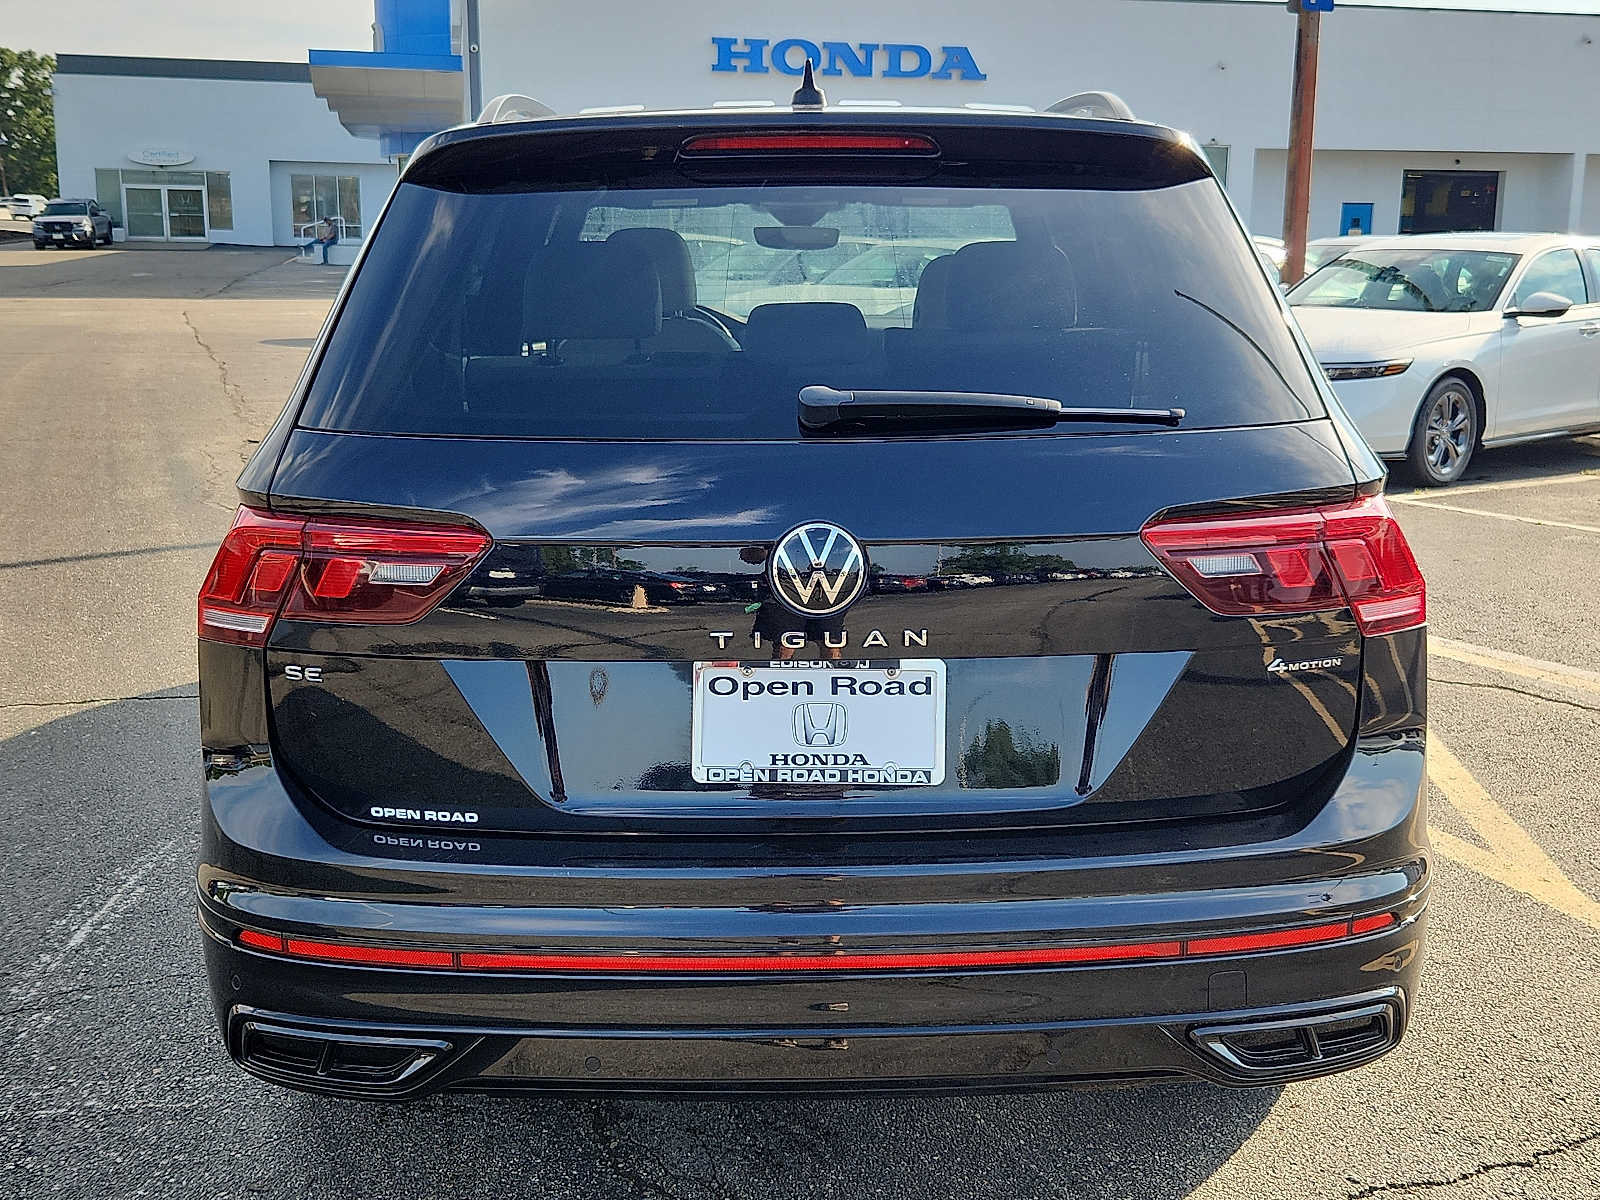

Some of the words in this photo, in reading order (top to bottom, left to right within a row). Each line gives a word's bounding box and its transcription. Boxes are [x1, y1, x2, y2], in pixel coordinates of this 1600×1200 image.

[711, 37, 987, 81] HONDA
[709, 629, 929, 649] TIGUAN
[285, 665, 323, 682] SE
[708, 676, 814, 701] Open
[830, 675, 932, 696] Road
[769, 753, 871, 766] HONDA
[708, 768, 770, 783] OPEN
[776, 768, 840, 783] ROAD
[846, 768, 930, 784] HONDA
[370, 806, 421, 820] OPEN
[424, 810, 479, 823] ROAD
